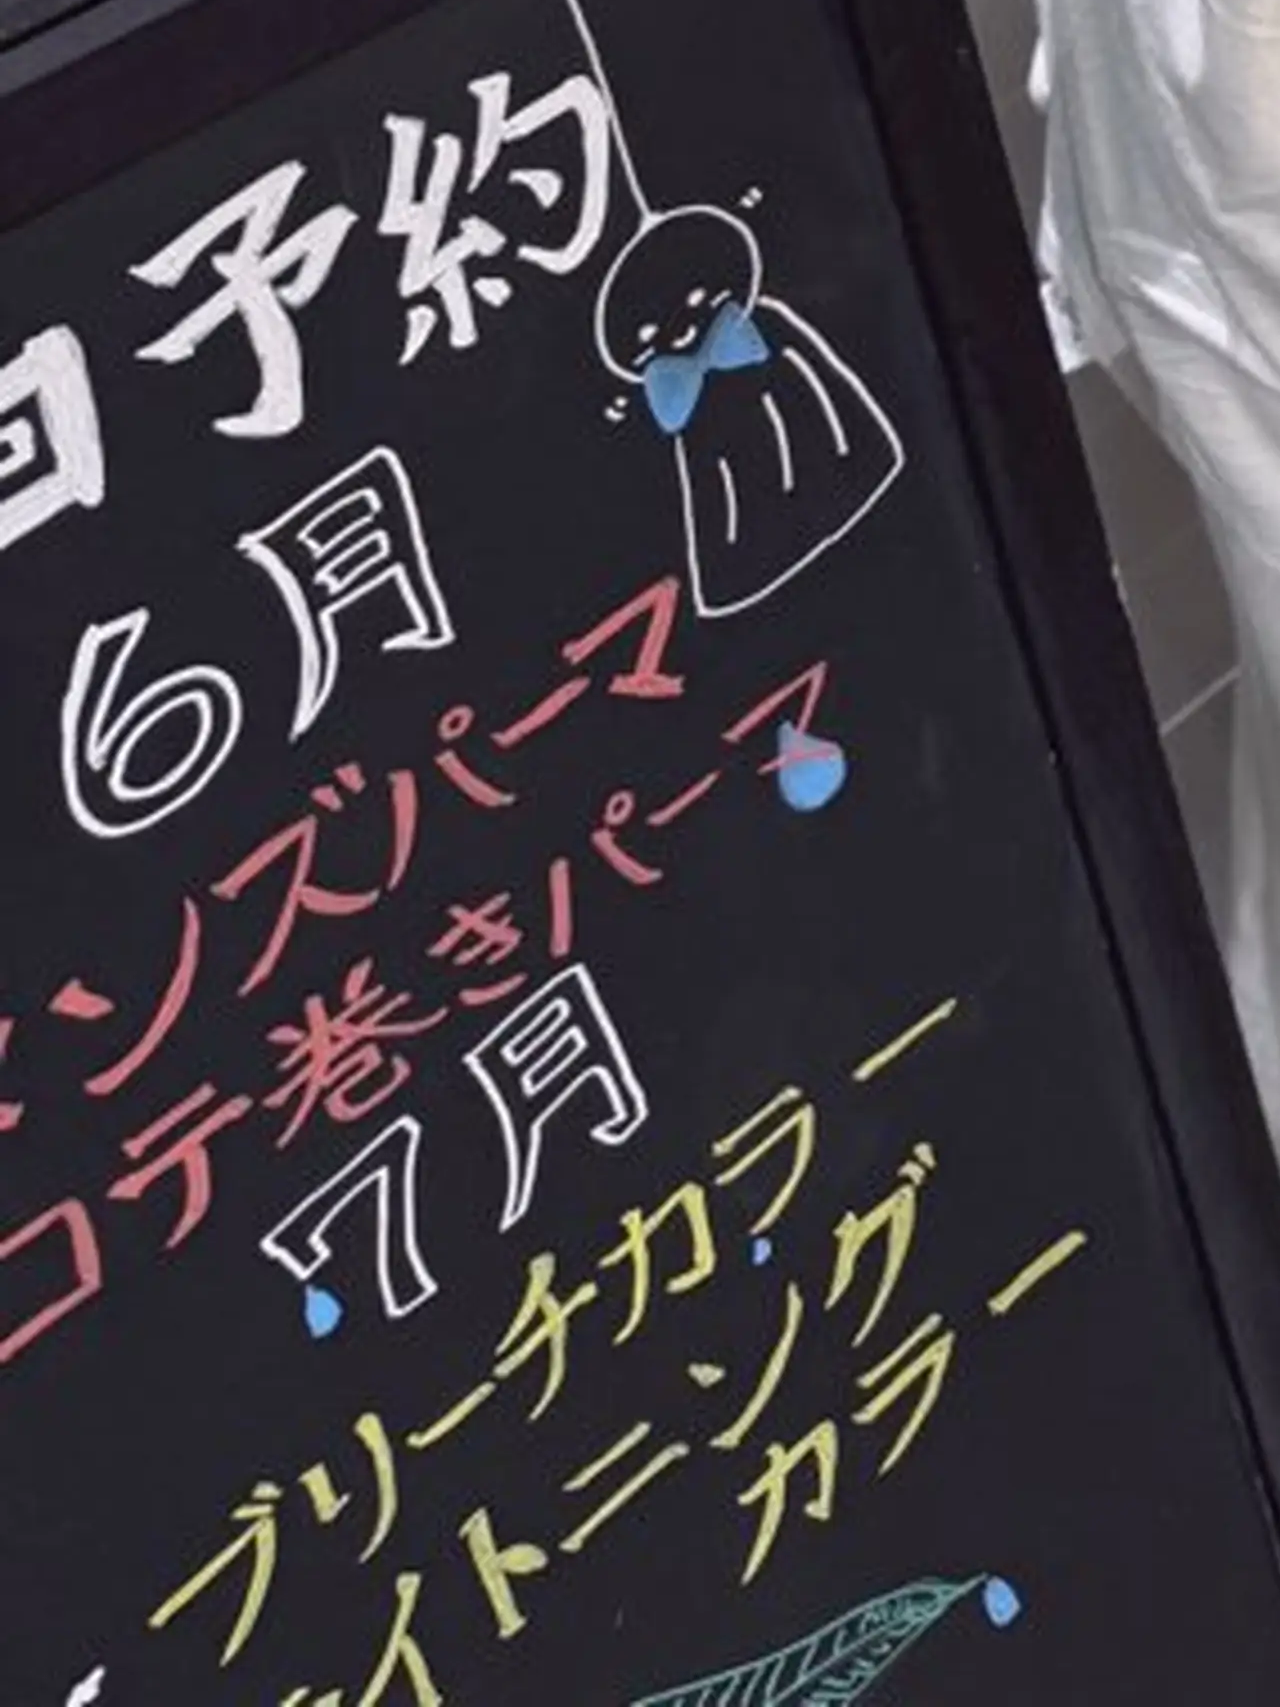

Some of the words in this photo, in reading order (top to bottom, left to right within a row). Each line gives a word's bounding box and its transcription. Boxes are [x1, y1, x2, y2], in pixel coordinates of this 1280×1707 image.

[0, 576, 684, 1132] ンズパーマ
[61, 445, 455, 838] 6月
[0, 661, 838, 1362] コテ巻きパーマ
[260, 962, 649, 1317] 7月
[149, 997, 957, 1668] ブリーチカラー
[280, 1142, 937, 1707] イトニング
[738, 1230, 1088, 1587] カラー
